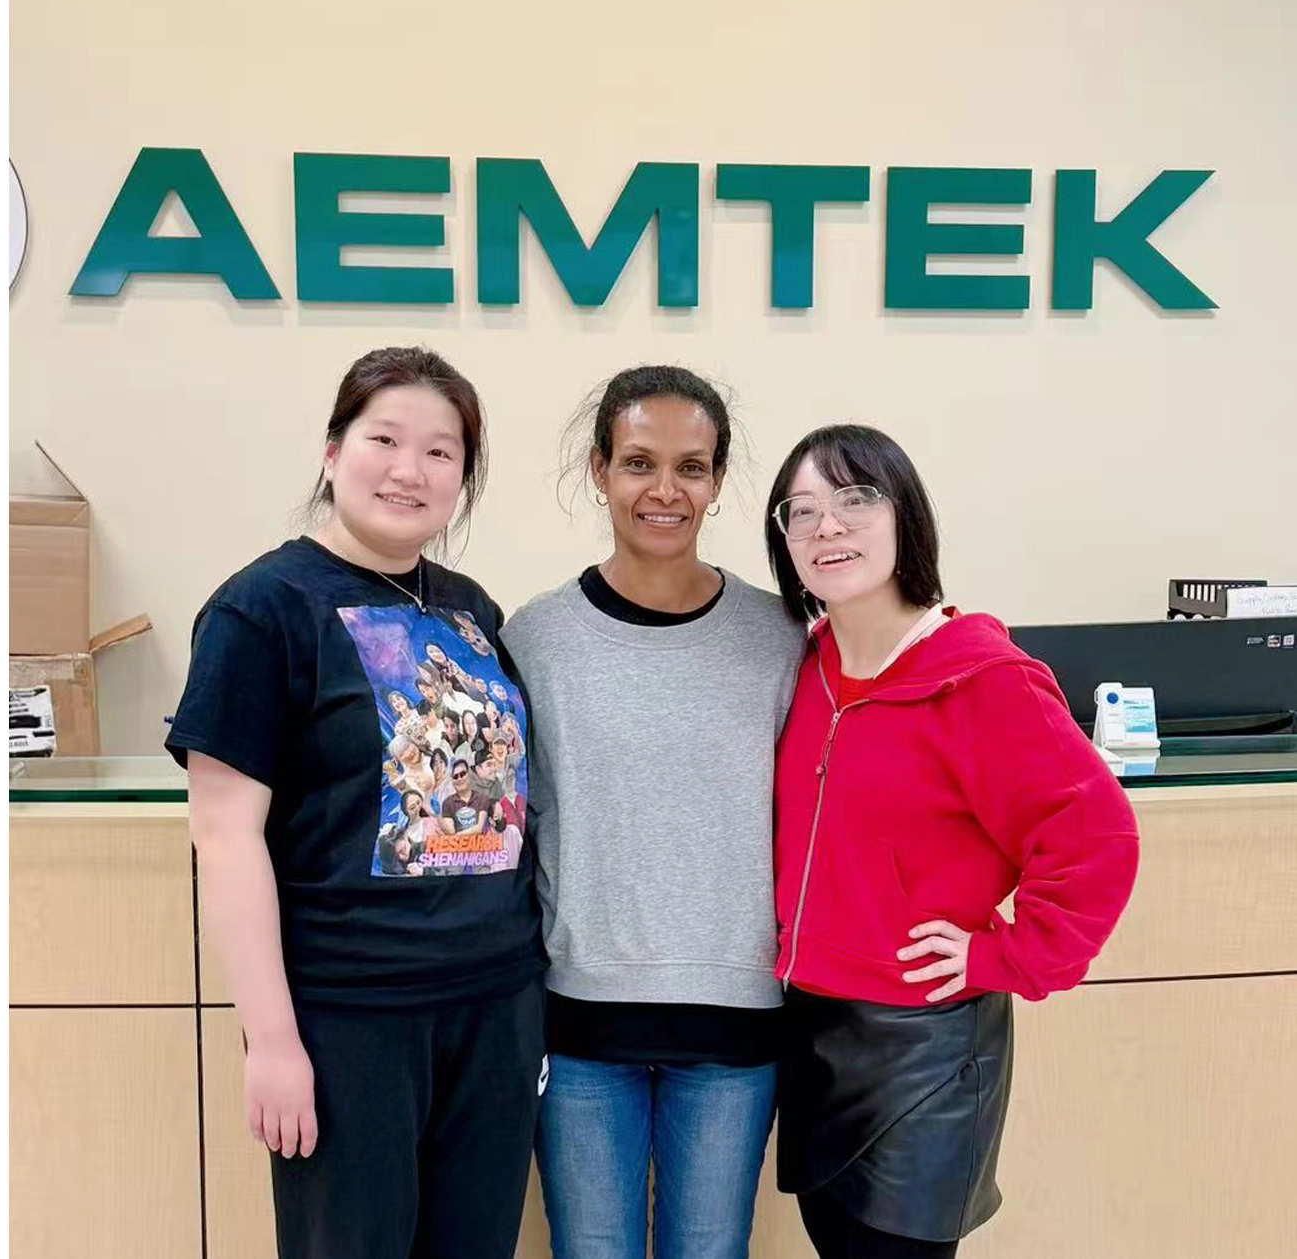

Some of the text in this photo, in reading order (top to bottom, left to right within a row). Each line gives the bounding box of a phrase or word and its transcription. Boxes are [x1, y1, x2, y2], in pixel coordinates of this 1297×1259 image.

[68, 146, 1220, 313] AEMTEK
[425, 834, 505, 853] RESEARCH
[418, 849, 509, 867] SHENANIGANS
